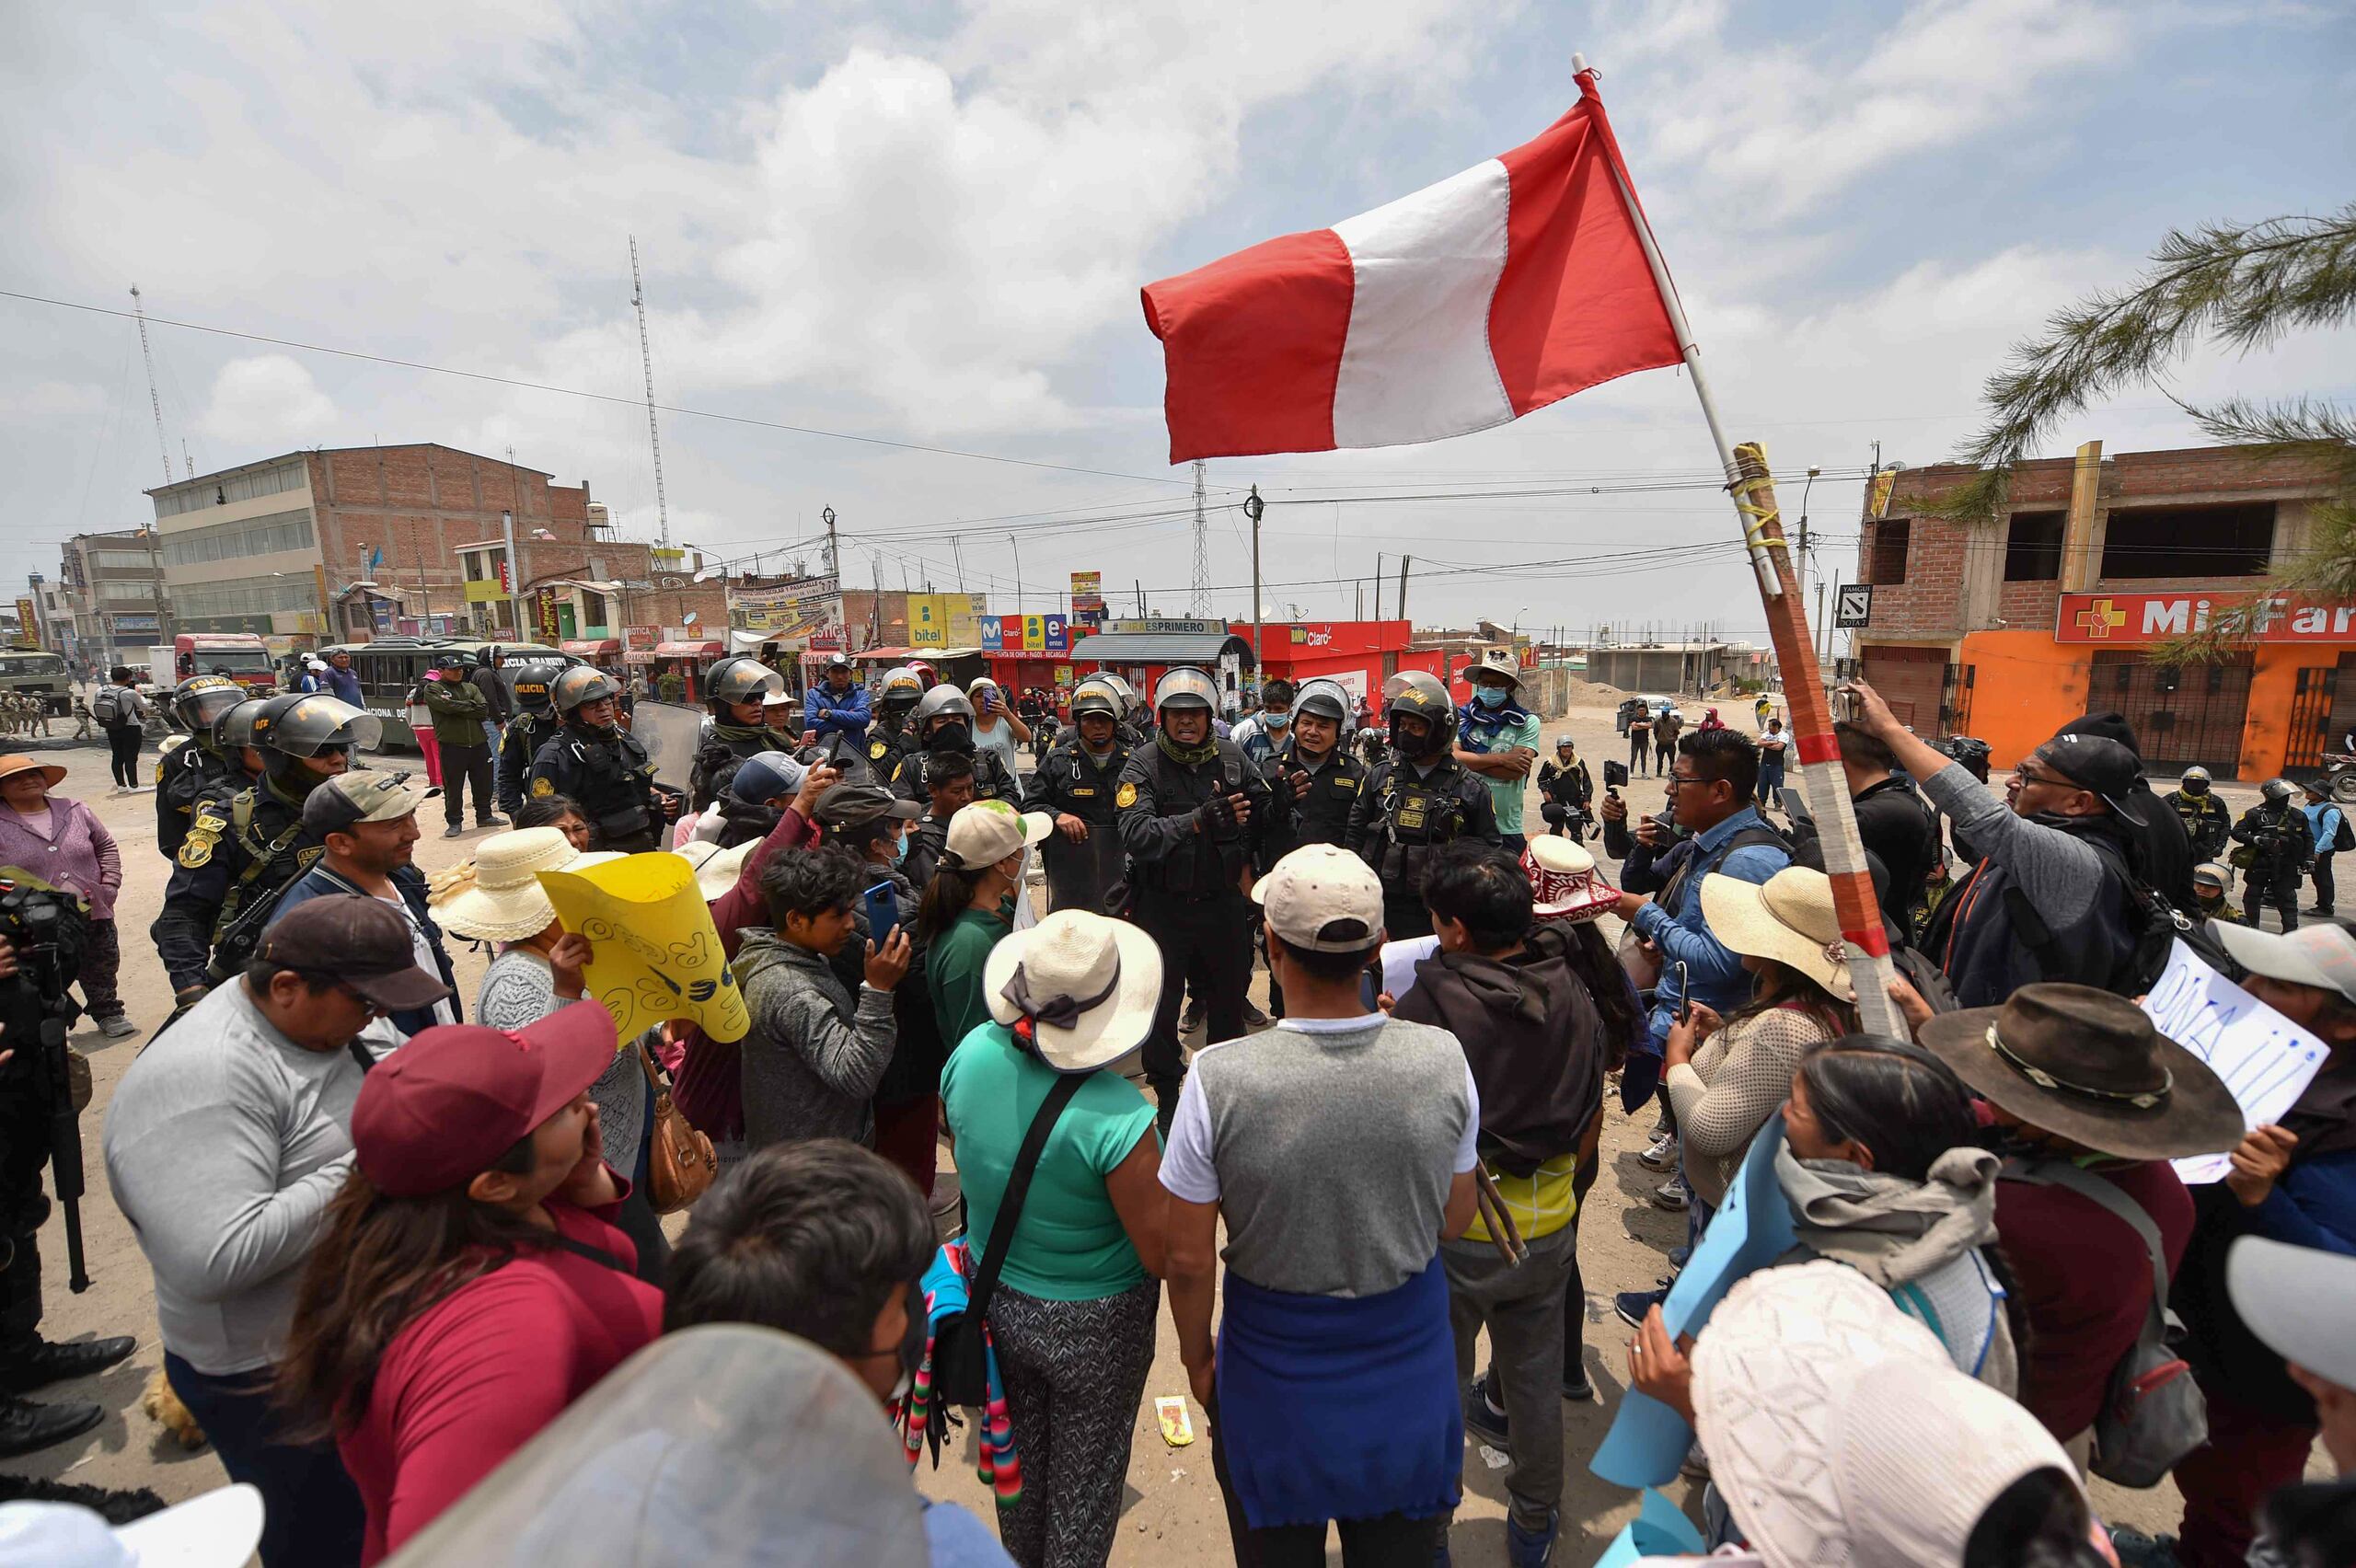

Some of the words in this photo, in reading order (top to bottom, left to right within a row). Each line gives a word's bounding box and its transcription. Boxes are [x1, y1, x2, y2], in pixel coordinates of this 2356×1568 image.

[628, 627, 650, 636] BOTICA
[915, 629, 941, 642] bitel
[1003, 629, 1019, 638] Claro
[1308, 629, 1330, 646] Claro
[1026, 640, 1042, 649] bitel
[801, 655, 827, 663] BOTIC
[514, 684, 546, 693] POLICIA
